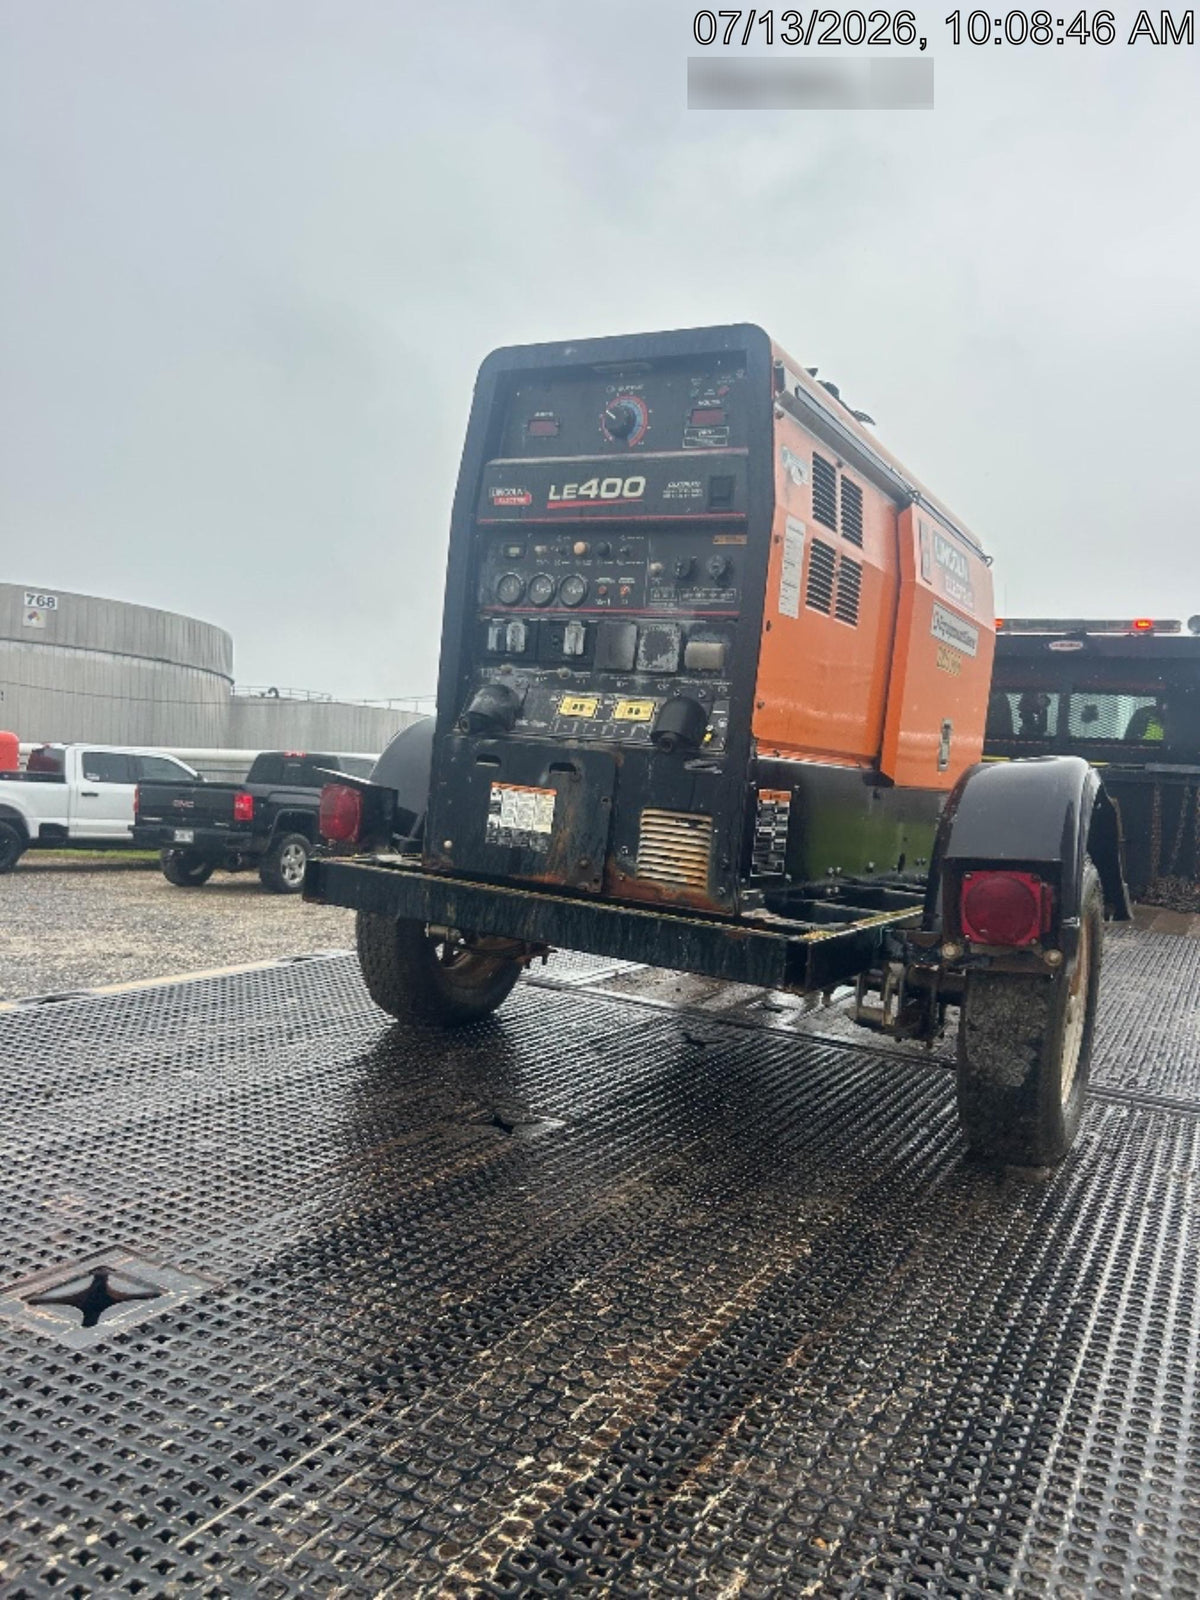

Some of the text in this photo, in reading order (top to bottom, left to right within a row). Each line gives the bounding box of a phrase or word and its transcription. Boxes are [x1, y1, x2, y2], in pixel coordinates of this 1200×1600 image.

[548, 475, 646, 500] LE400
[26, 593, 56, 608] 768
[173, 799, 195, 808] GMC
